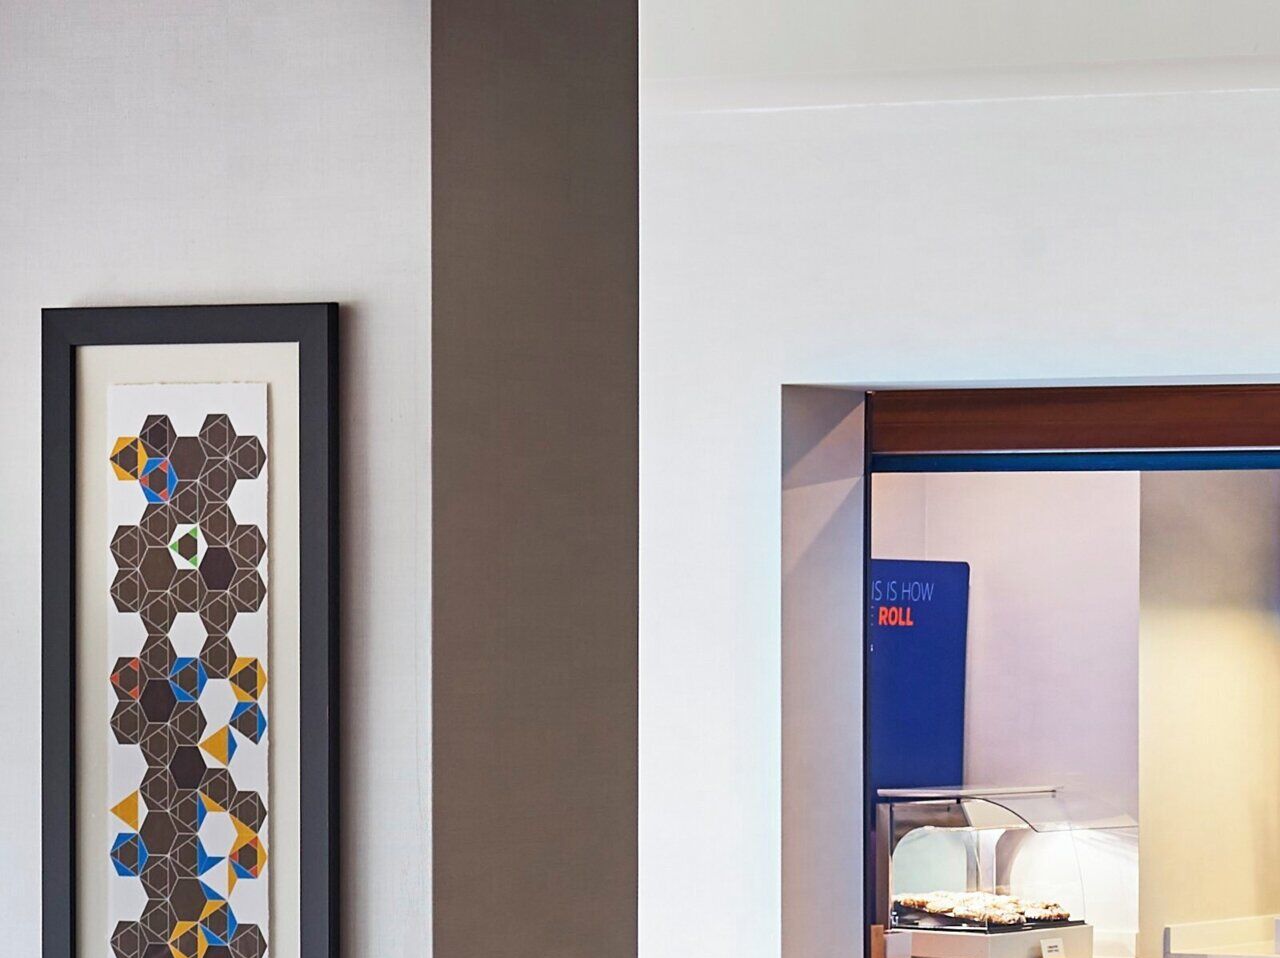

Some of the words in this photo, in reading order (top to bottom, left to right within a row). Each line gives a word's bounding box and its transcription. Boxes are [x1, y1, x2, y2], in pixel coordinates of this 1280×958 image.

[886, 581, 898, 601] IS
[901, 581, 935, 601] HOW
[878, 606, 914, 626] ROLL
